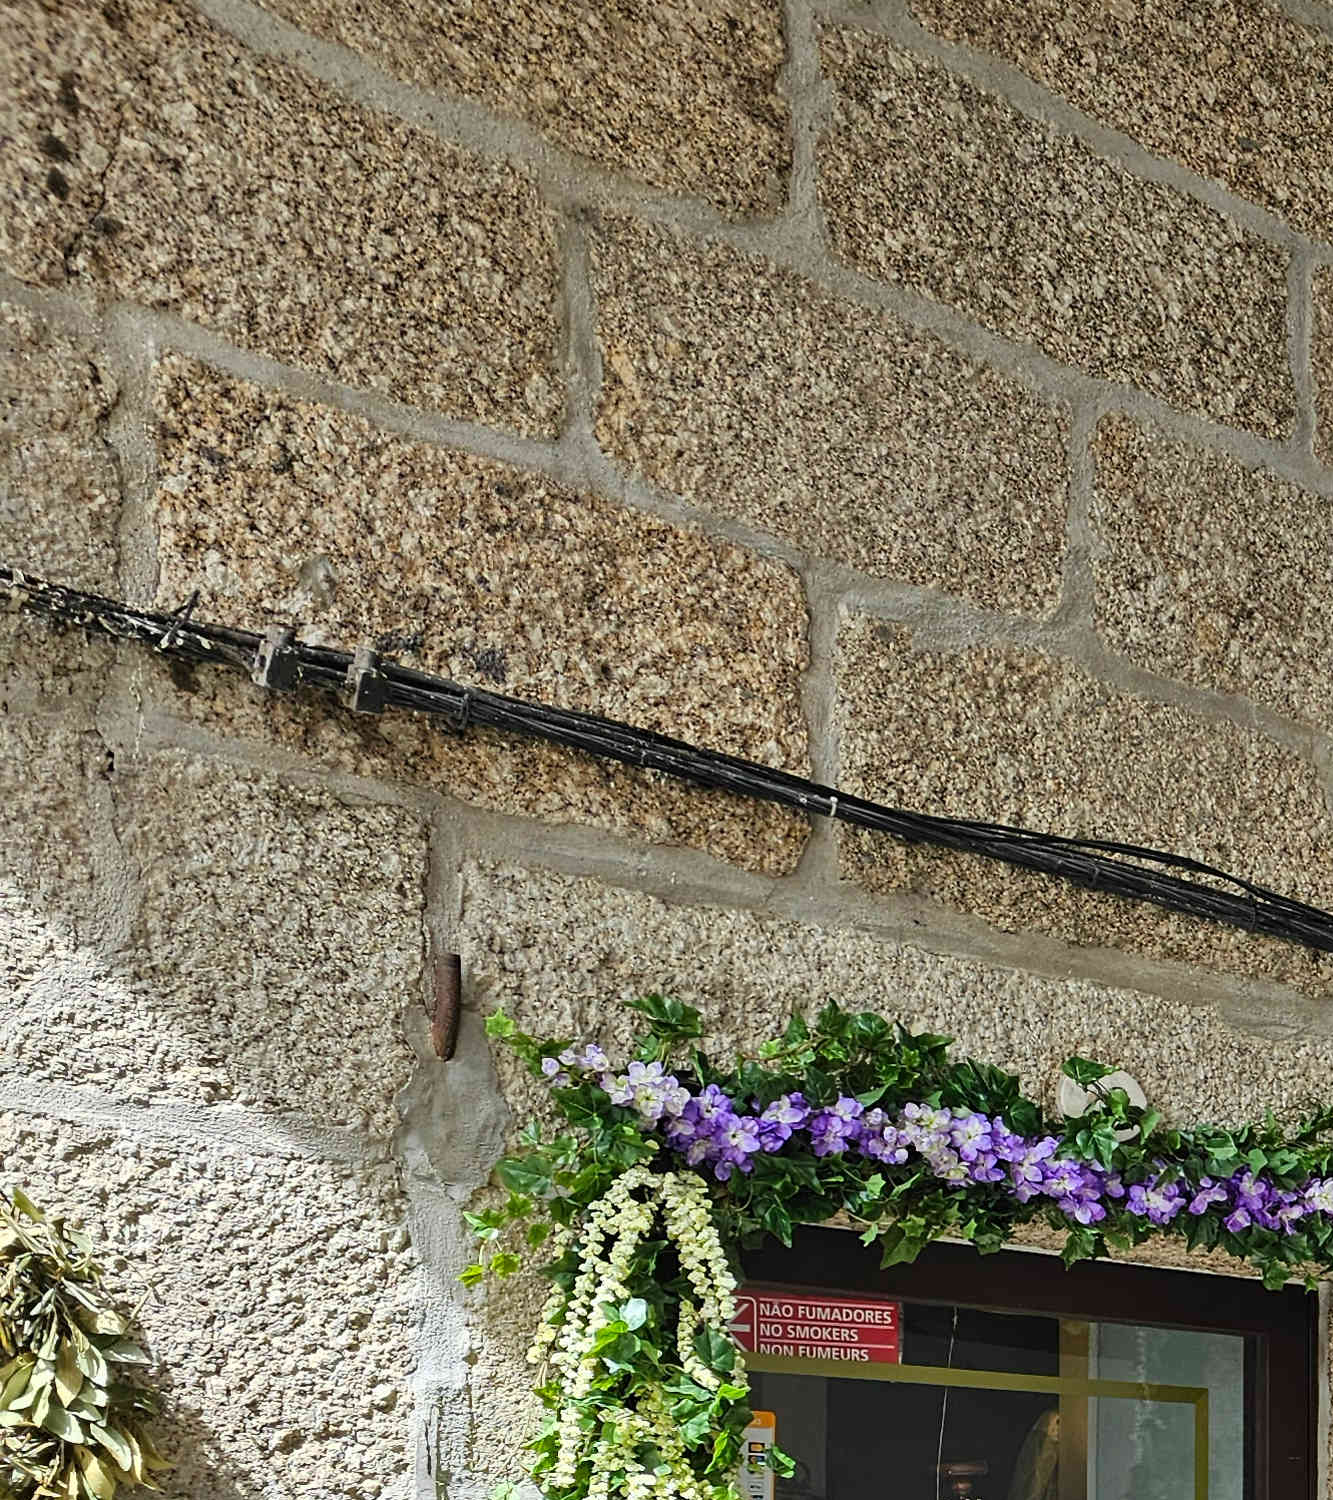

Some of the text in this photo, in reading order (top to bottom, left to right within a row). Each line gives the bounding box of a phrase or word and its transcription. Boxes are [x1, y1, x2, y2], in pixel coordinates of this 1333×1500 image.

[760, 1303, 892, 1324] NÃO FUMADORES
[760, 1324, 859, 1342] NO SMOKERS
[760, 1344, 869, 1362] NON FUMEURS
